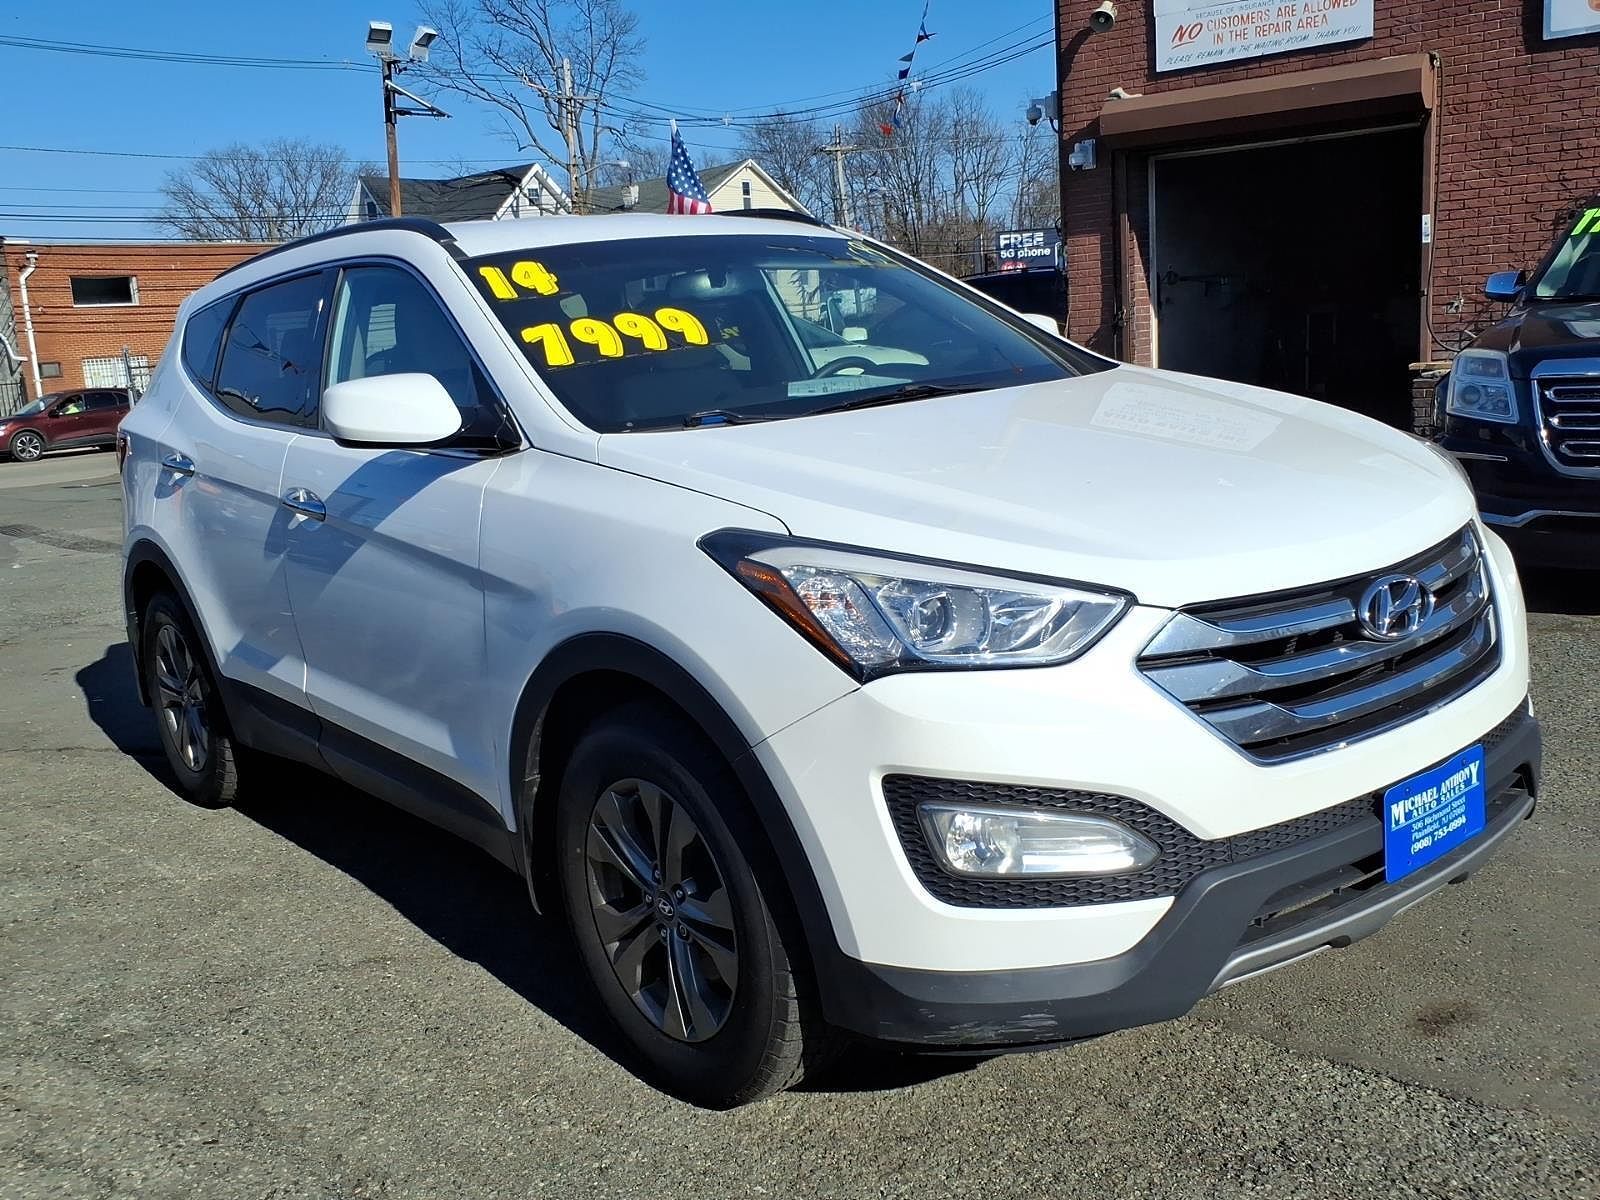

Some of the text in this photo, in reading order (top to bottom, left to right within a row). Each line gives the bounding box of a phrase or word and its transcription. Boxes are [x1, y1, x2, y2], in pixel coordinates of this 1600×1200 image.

[1206, 0, 1358, 32] CUSTOMERS ARE ALLOWED
[1213, 14, 1328, 45] IN THE REPAIR AREA
[1165, 54, 1193, 65] PLEASE
[1197, 49, 1224, 59] REMAIN
[1240, 43, 1253, 53] THE
[1254, 37, 1284, 51] WAITING
[1285, 34, 1310, 45] ROOM
[1315, 29, 1342, 40] THANK
[1343, 24, 1361, 35] YOU
[1171, 22, 1203, 43] NO
[1000, 231, 1044, 249] FREE
[1000, 247, 1051, 259] 5G phone
[479, 261, 560, 299] 14
[521, 307, 709, 367] 7999
[1391, 760, 1480, 829] MICHAEL ANTHONY
[1412, 782, 1465, 818] AUTO SALES
[1424, 804, 1451, 826] Richmond
[1411, 835, 1433, 855] (908)
